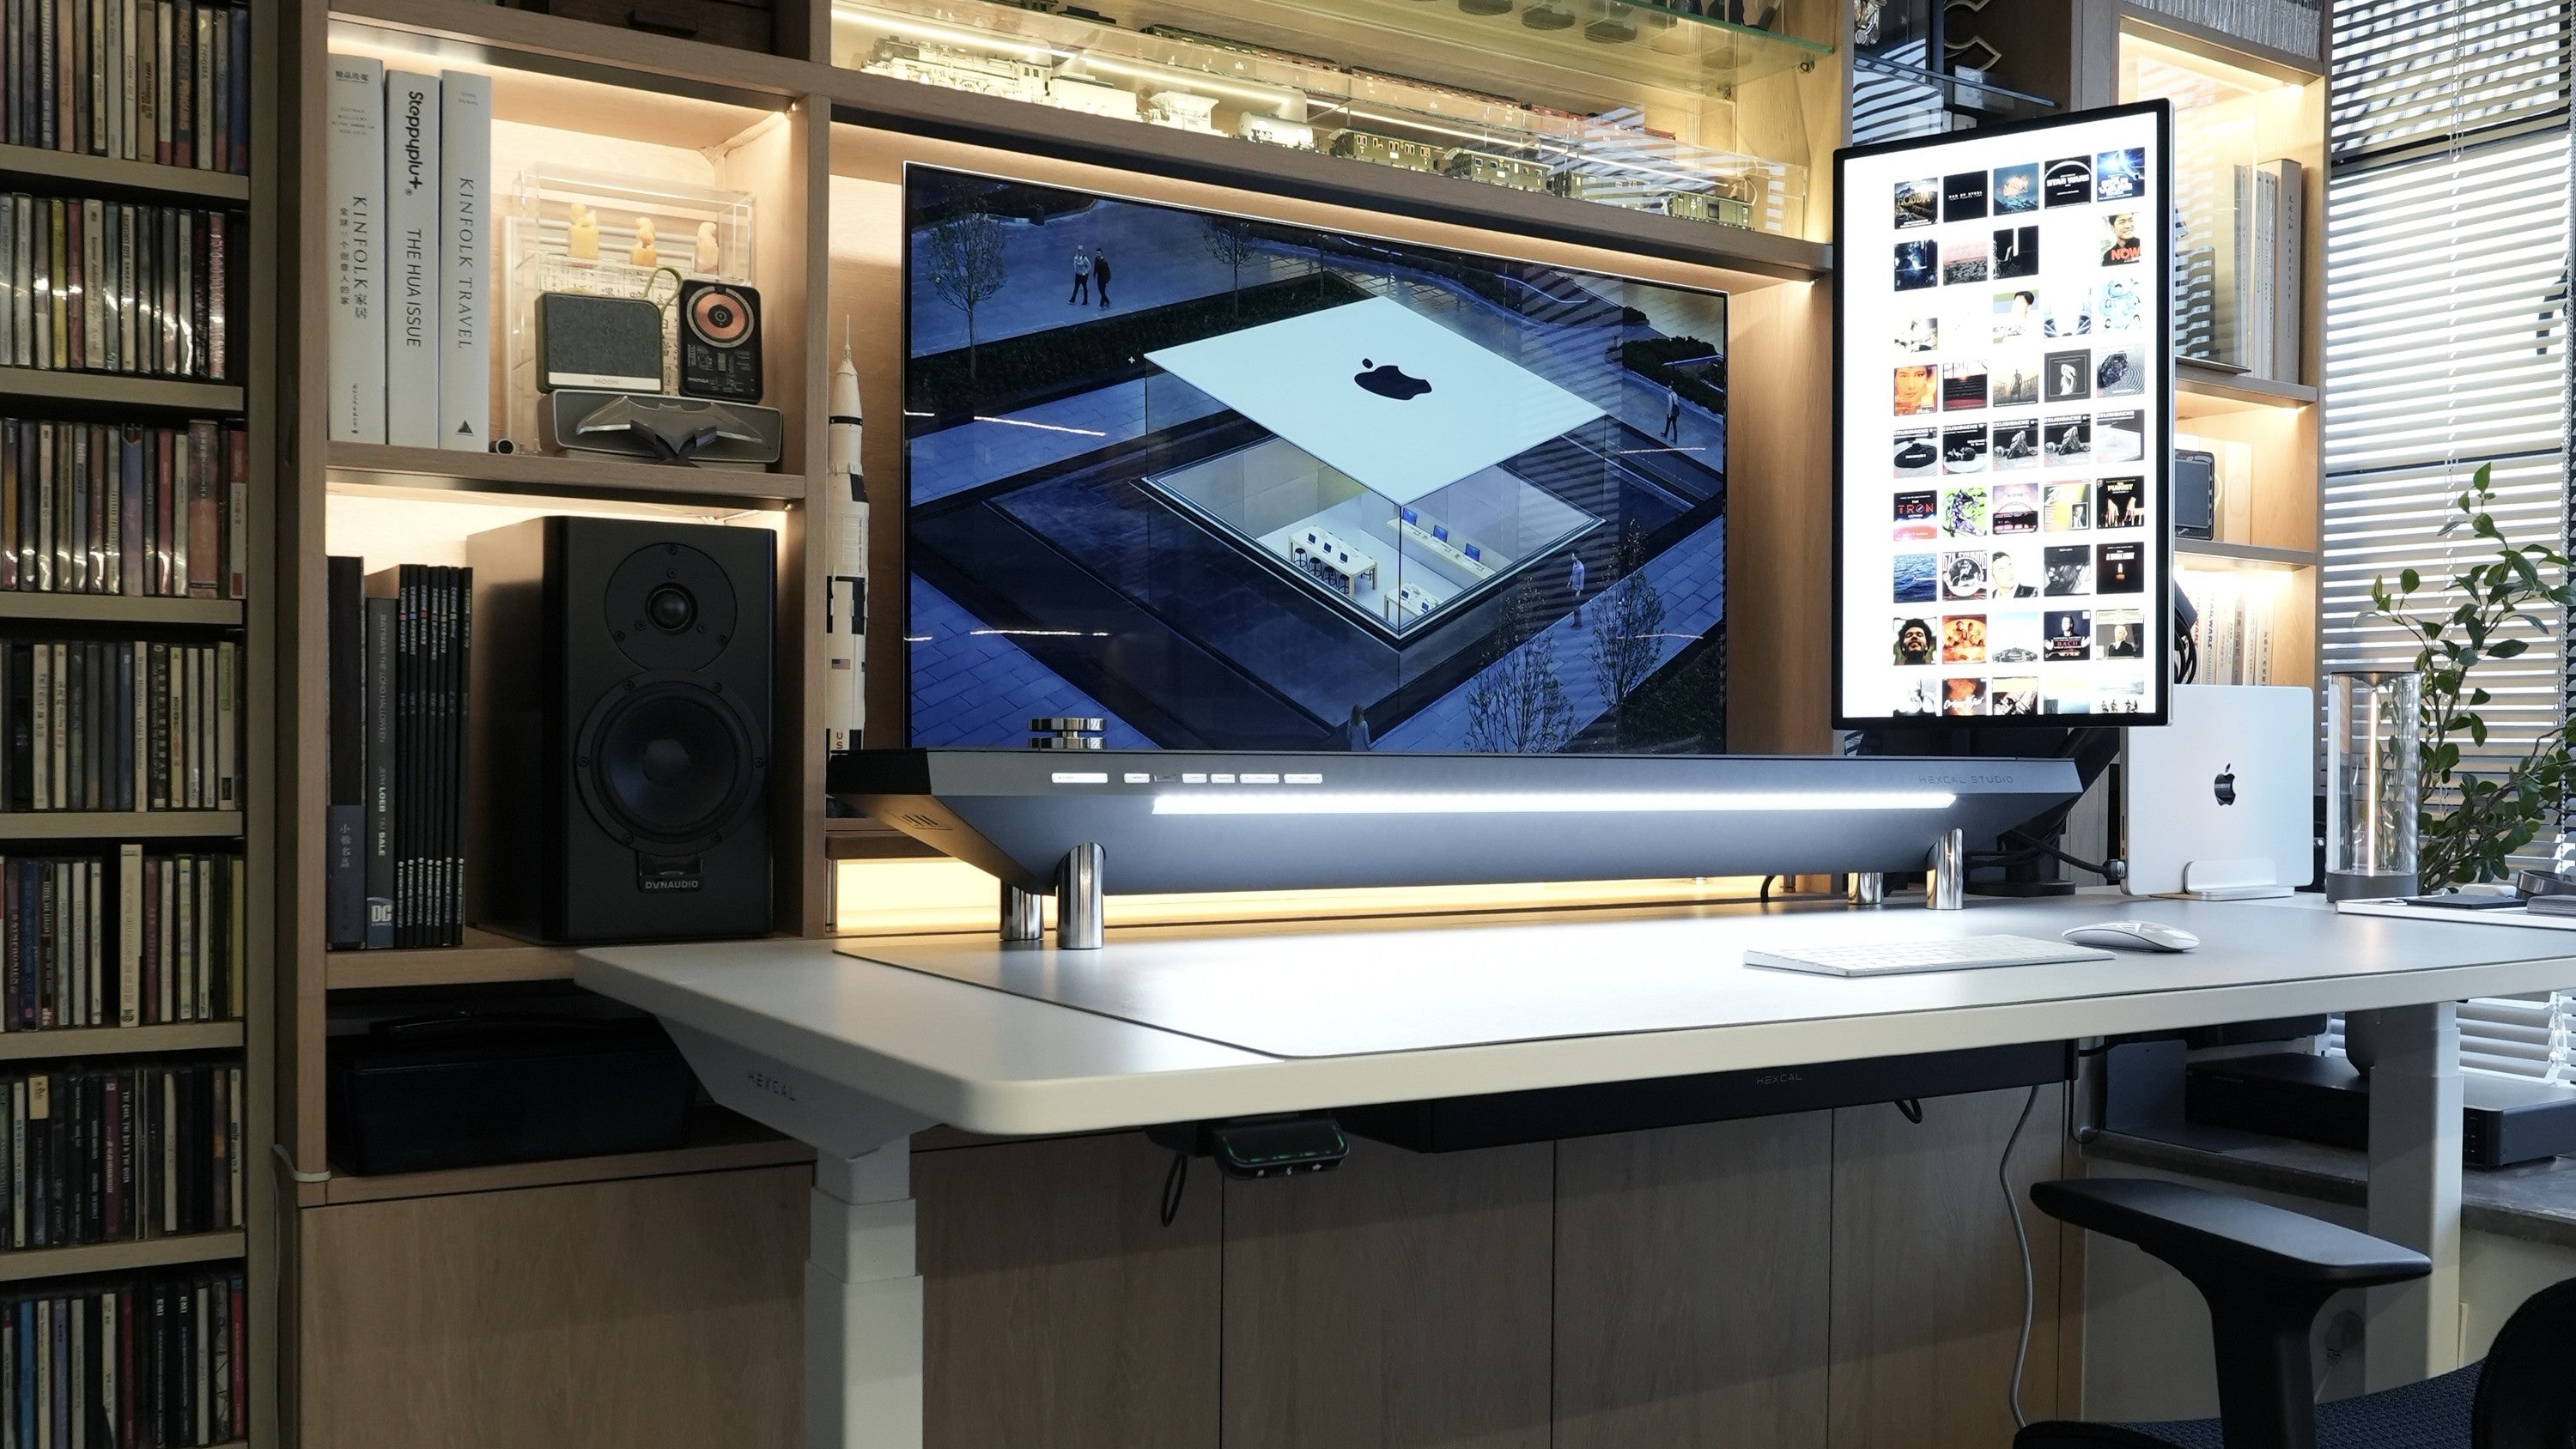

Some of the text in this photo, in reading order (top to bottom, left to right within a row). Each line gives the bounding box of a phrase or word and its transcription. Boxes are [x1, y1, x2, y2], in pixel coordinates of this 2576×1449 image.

[353, 196, 368, 293] KINFOLK
[2111, 246, 2141, 261] NOW
[458, 178, 474, 349] KINFOLK TRAVEL
[406, 228, 422, 348] THE HUA ISSUE
[1897, 503, 1934, 514] TRON
[378, 657, 386, 670] THE
[1918, 775, 2014, 785] HEXCAL STUDIO
[378, 786, 386, 813] LOEB
[645, 880, 699, 889] DYNAUDIO
[371, 905, 392, 923] DC
[748, 1072, 797, 1101] HEXCAL
[1756, 1073, 1803, 1085] HEXCAL
[155, 1299, 165, 1316] EMI
[179, 1296, 188, 1313] EMI
